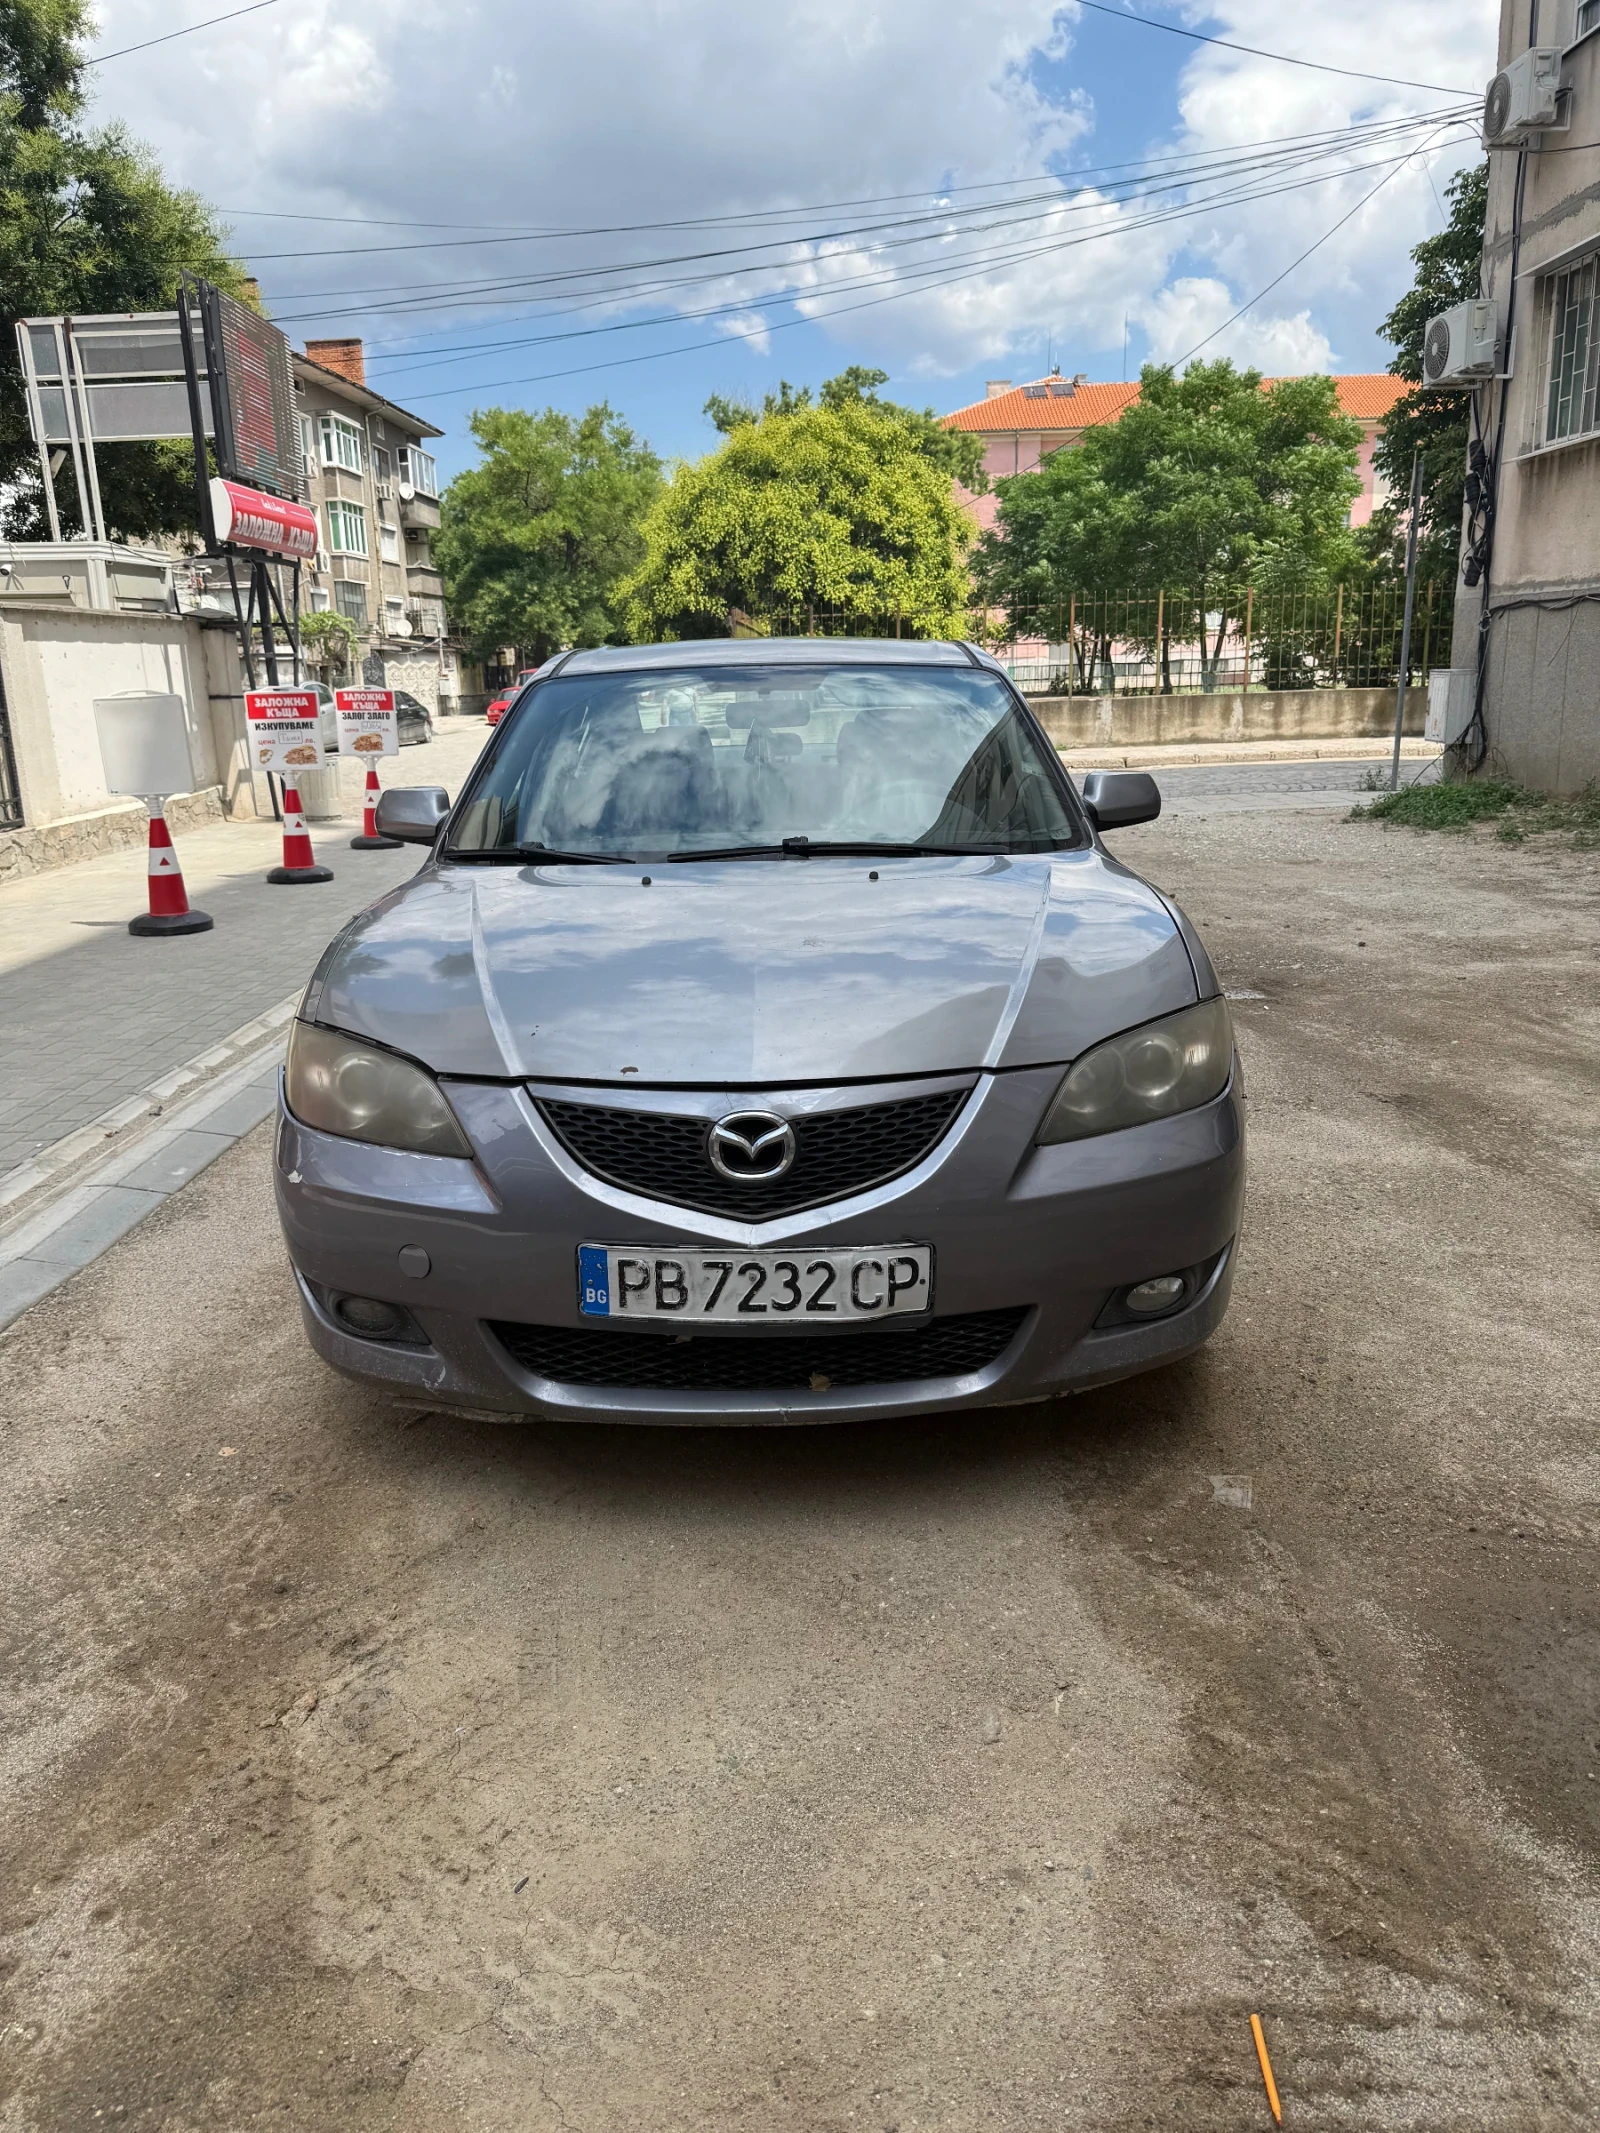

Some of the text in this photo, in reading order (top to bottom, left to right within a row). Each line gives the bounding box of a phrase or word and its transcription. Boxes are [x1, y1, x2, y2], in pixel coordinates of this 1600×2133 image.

[234, 511, 314, 553] ЗАЛОЖНА КЪЩА
[254, 697, 309, 708] ЗАЛОЖНА
[342, 693, 387, 702] ЗАЛОЖНА
[352, 702, 380, 711] КЪЩА
[266, 707, 300, 718] КЪЩА
[342, 712, 366, 720] ЗАЛОГ
[254, 721, 315, 731] ИЗКУПУВАМЕ
[617, 1258, 689, 1311] PB
[701, 1260, 838, 1313] 7232
[585, 1288, 607, 1304] BG
